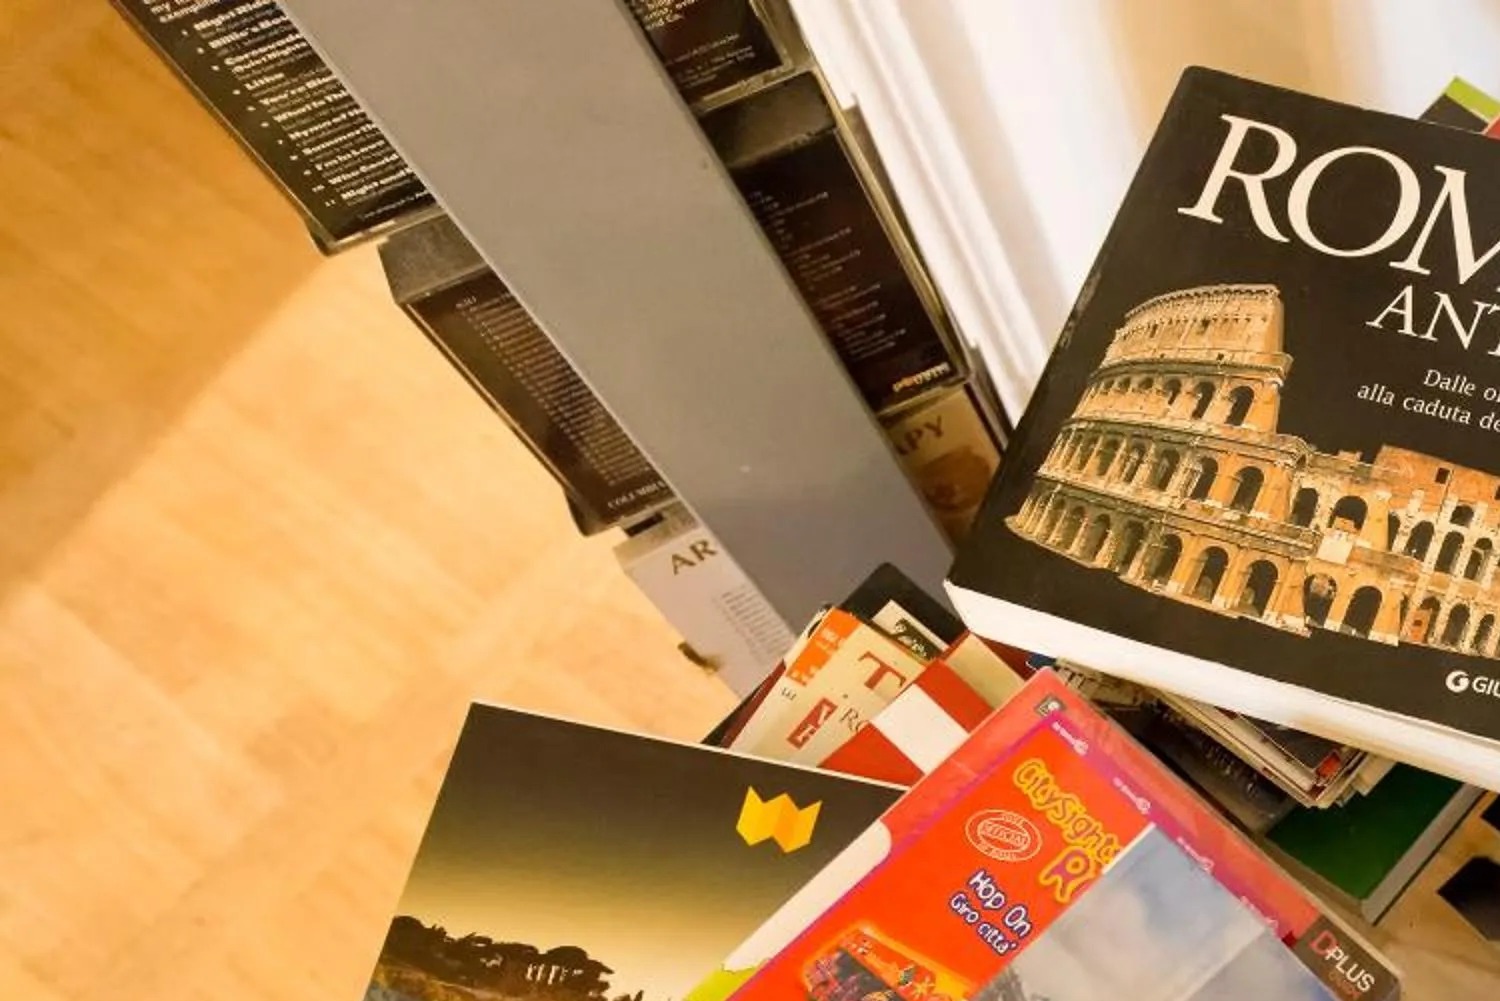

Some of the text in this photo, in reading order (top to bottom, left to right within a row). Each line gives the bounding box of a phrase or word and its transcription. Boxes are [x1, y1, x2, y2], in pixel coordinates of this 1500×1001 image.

[1423, 368, 1477, 396] Dalle
[1356, 381, 1395, 408] alla
[1402, 394, 1472, 426] caduta
[948, 890, 981, 927] Giro
[968, 869, 1034, 938] Hop On
